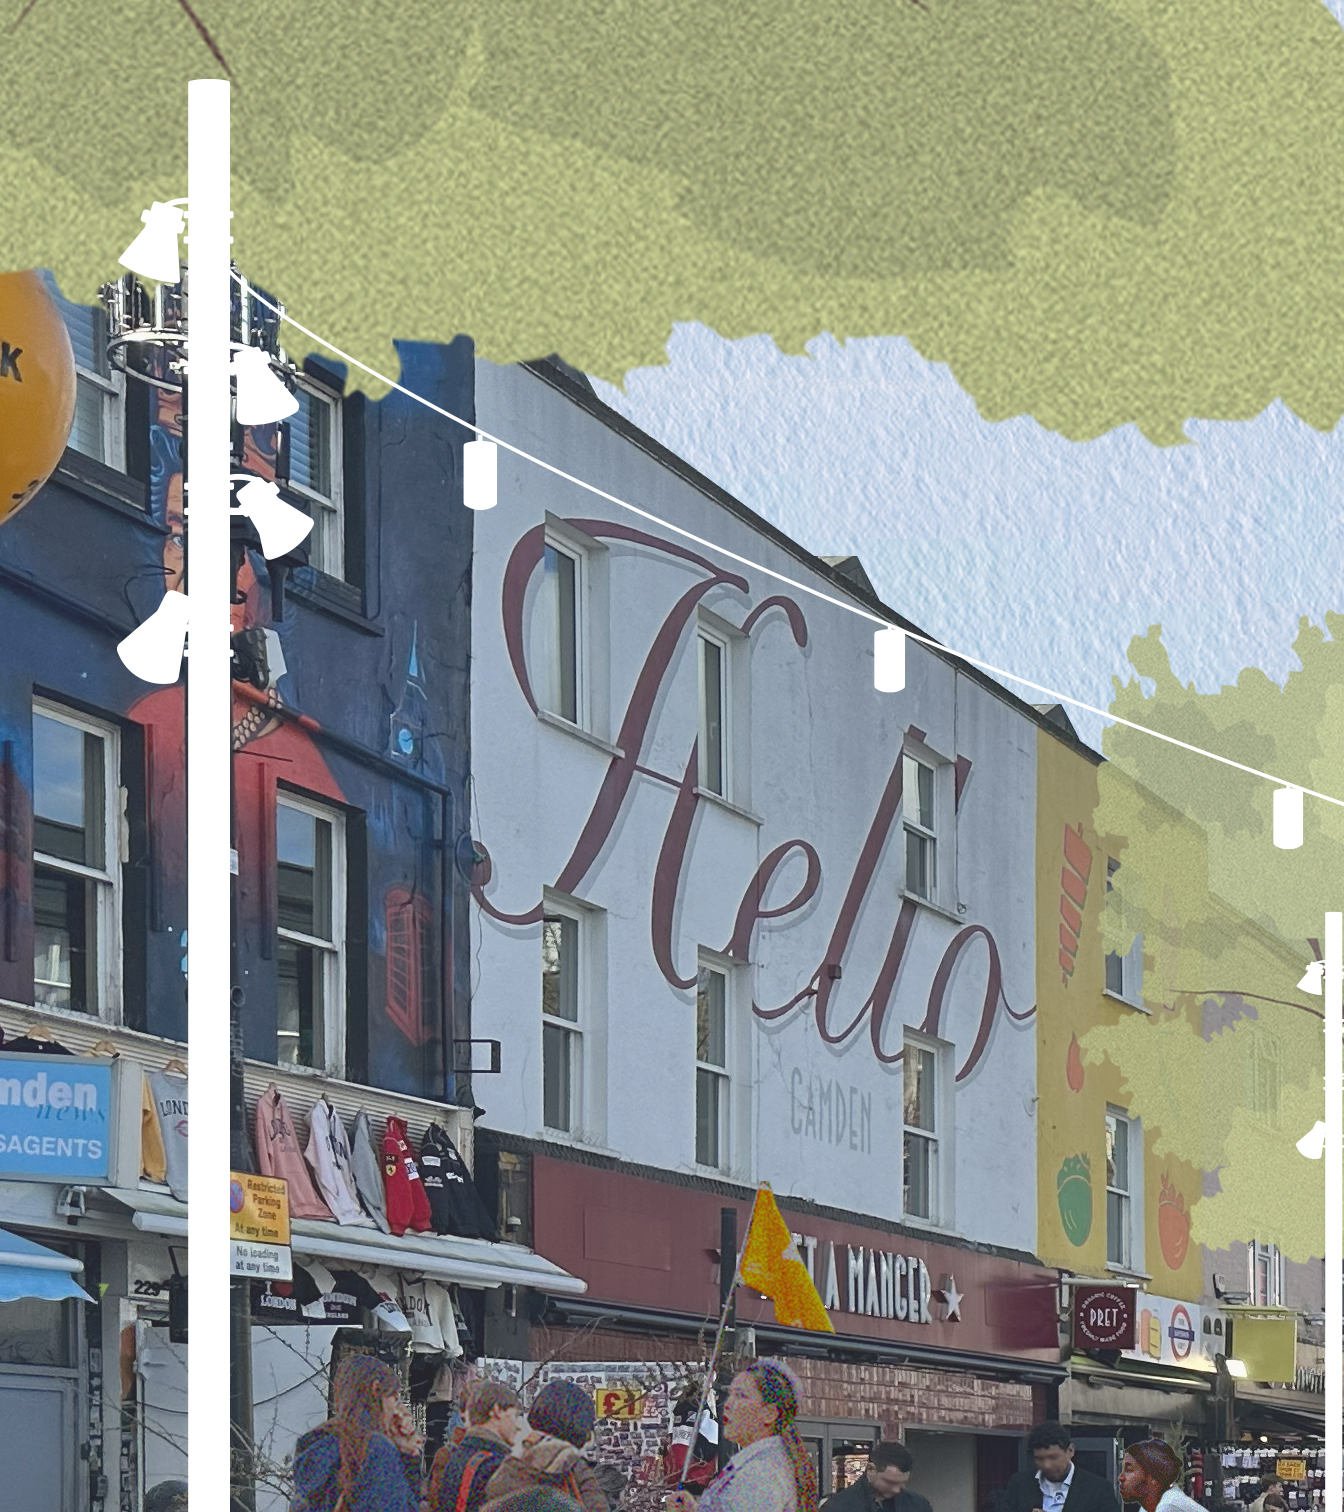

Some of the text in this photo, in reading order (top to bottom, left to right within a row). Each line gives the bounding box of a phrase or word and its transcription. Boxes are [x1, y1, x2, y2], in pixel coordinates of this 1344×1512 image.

[471, 517, 1037, 1082] Hello
[36, 1104, 105, 1123] news
[791, 1066, 872, 1154] CAMDEN
[247, 1179, 286, 1195] Restricted
[252, 1193, 281, 1210] Parking
[257, 1208, 277, 1220] Zone
[235, 1222, 279, 1238] At any time
[236, 1246, 279, 1261] No loading
[235, 1260, 280, 1274] at any time
[847, 1243, 933, 1324] MANGER
[260, 1295, 297, 1311] LONDON
[1089, 1308, 1118, 1327] PRET
[603, 1392, 635, 1415] £1
